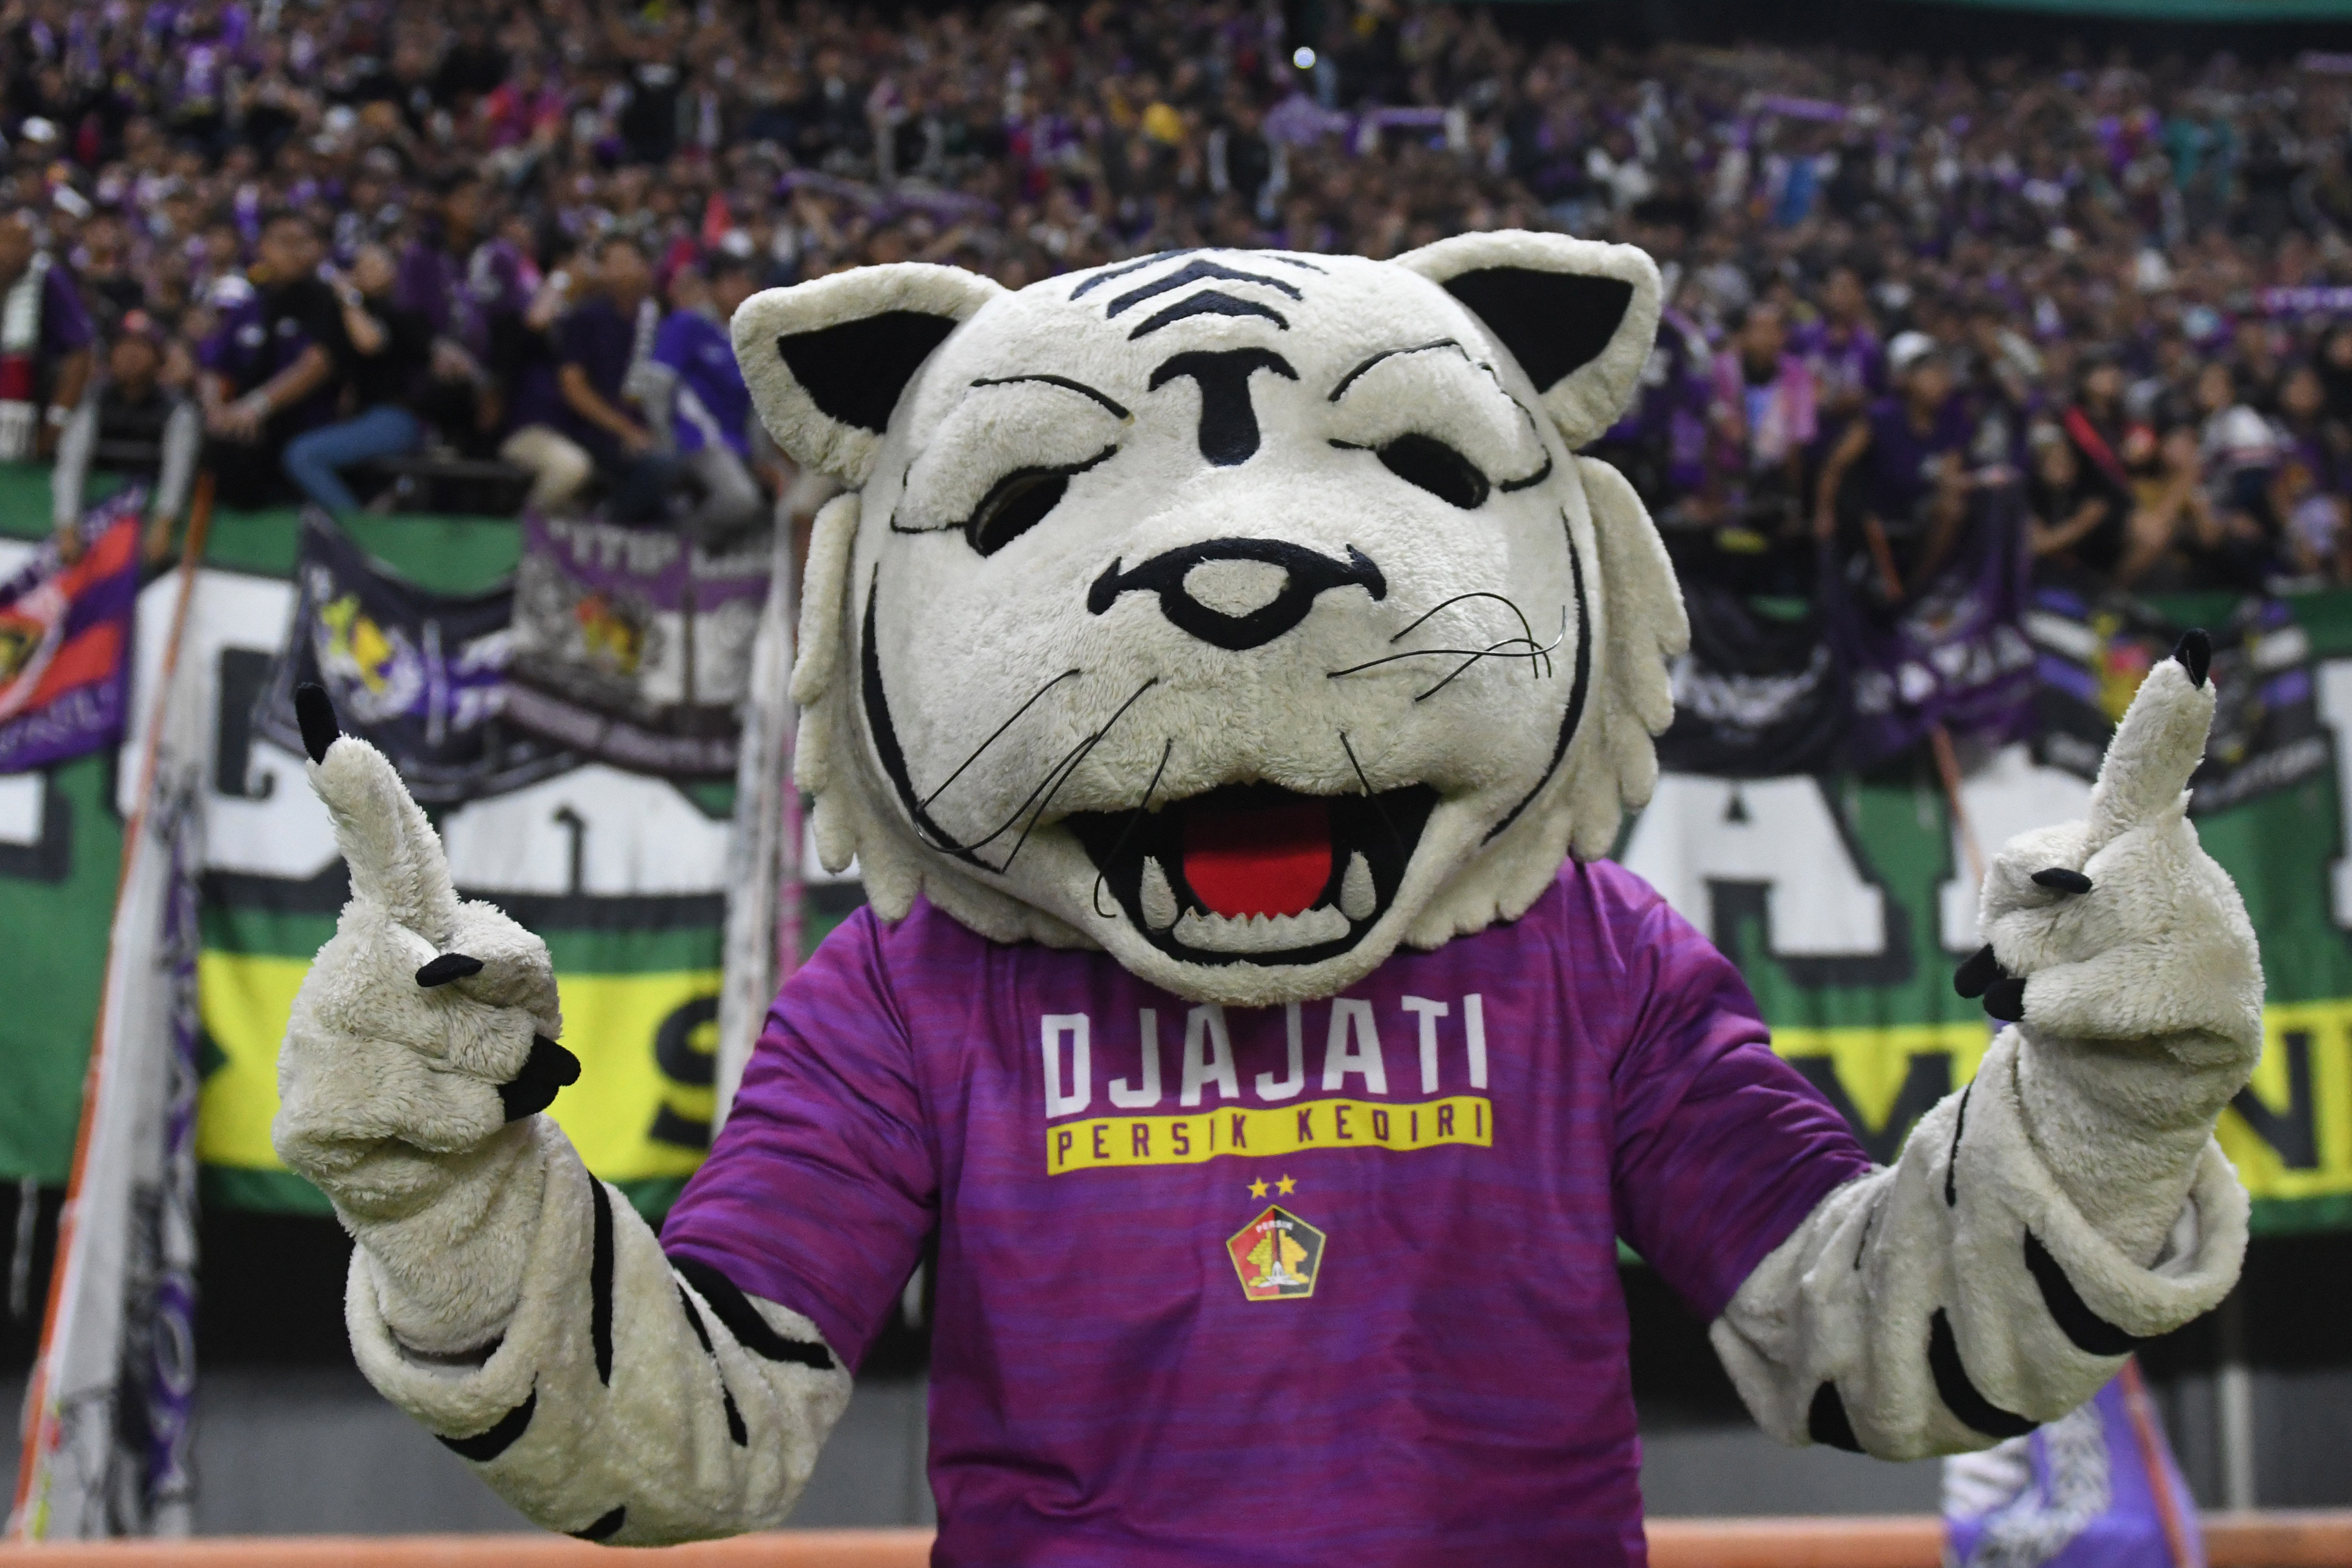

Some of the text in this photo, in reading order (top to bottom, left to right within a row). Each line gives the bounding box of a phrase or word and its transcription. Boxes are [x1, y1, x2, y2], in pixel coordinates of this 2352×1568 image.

[1041, 993, 1487, 1119] DJAJATI
[1058, 1104, 1482, 1166] PERSIK KEDIRI
